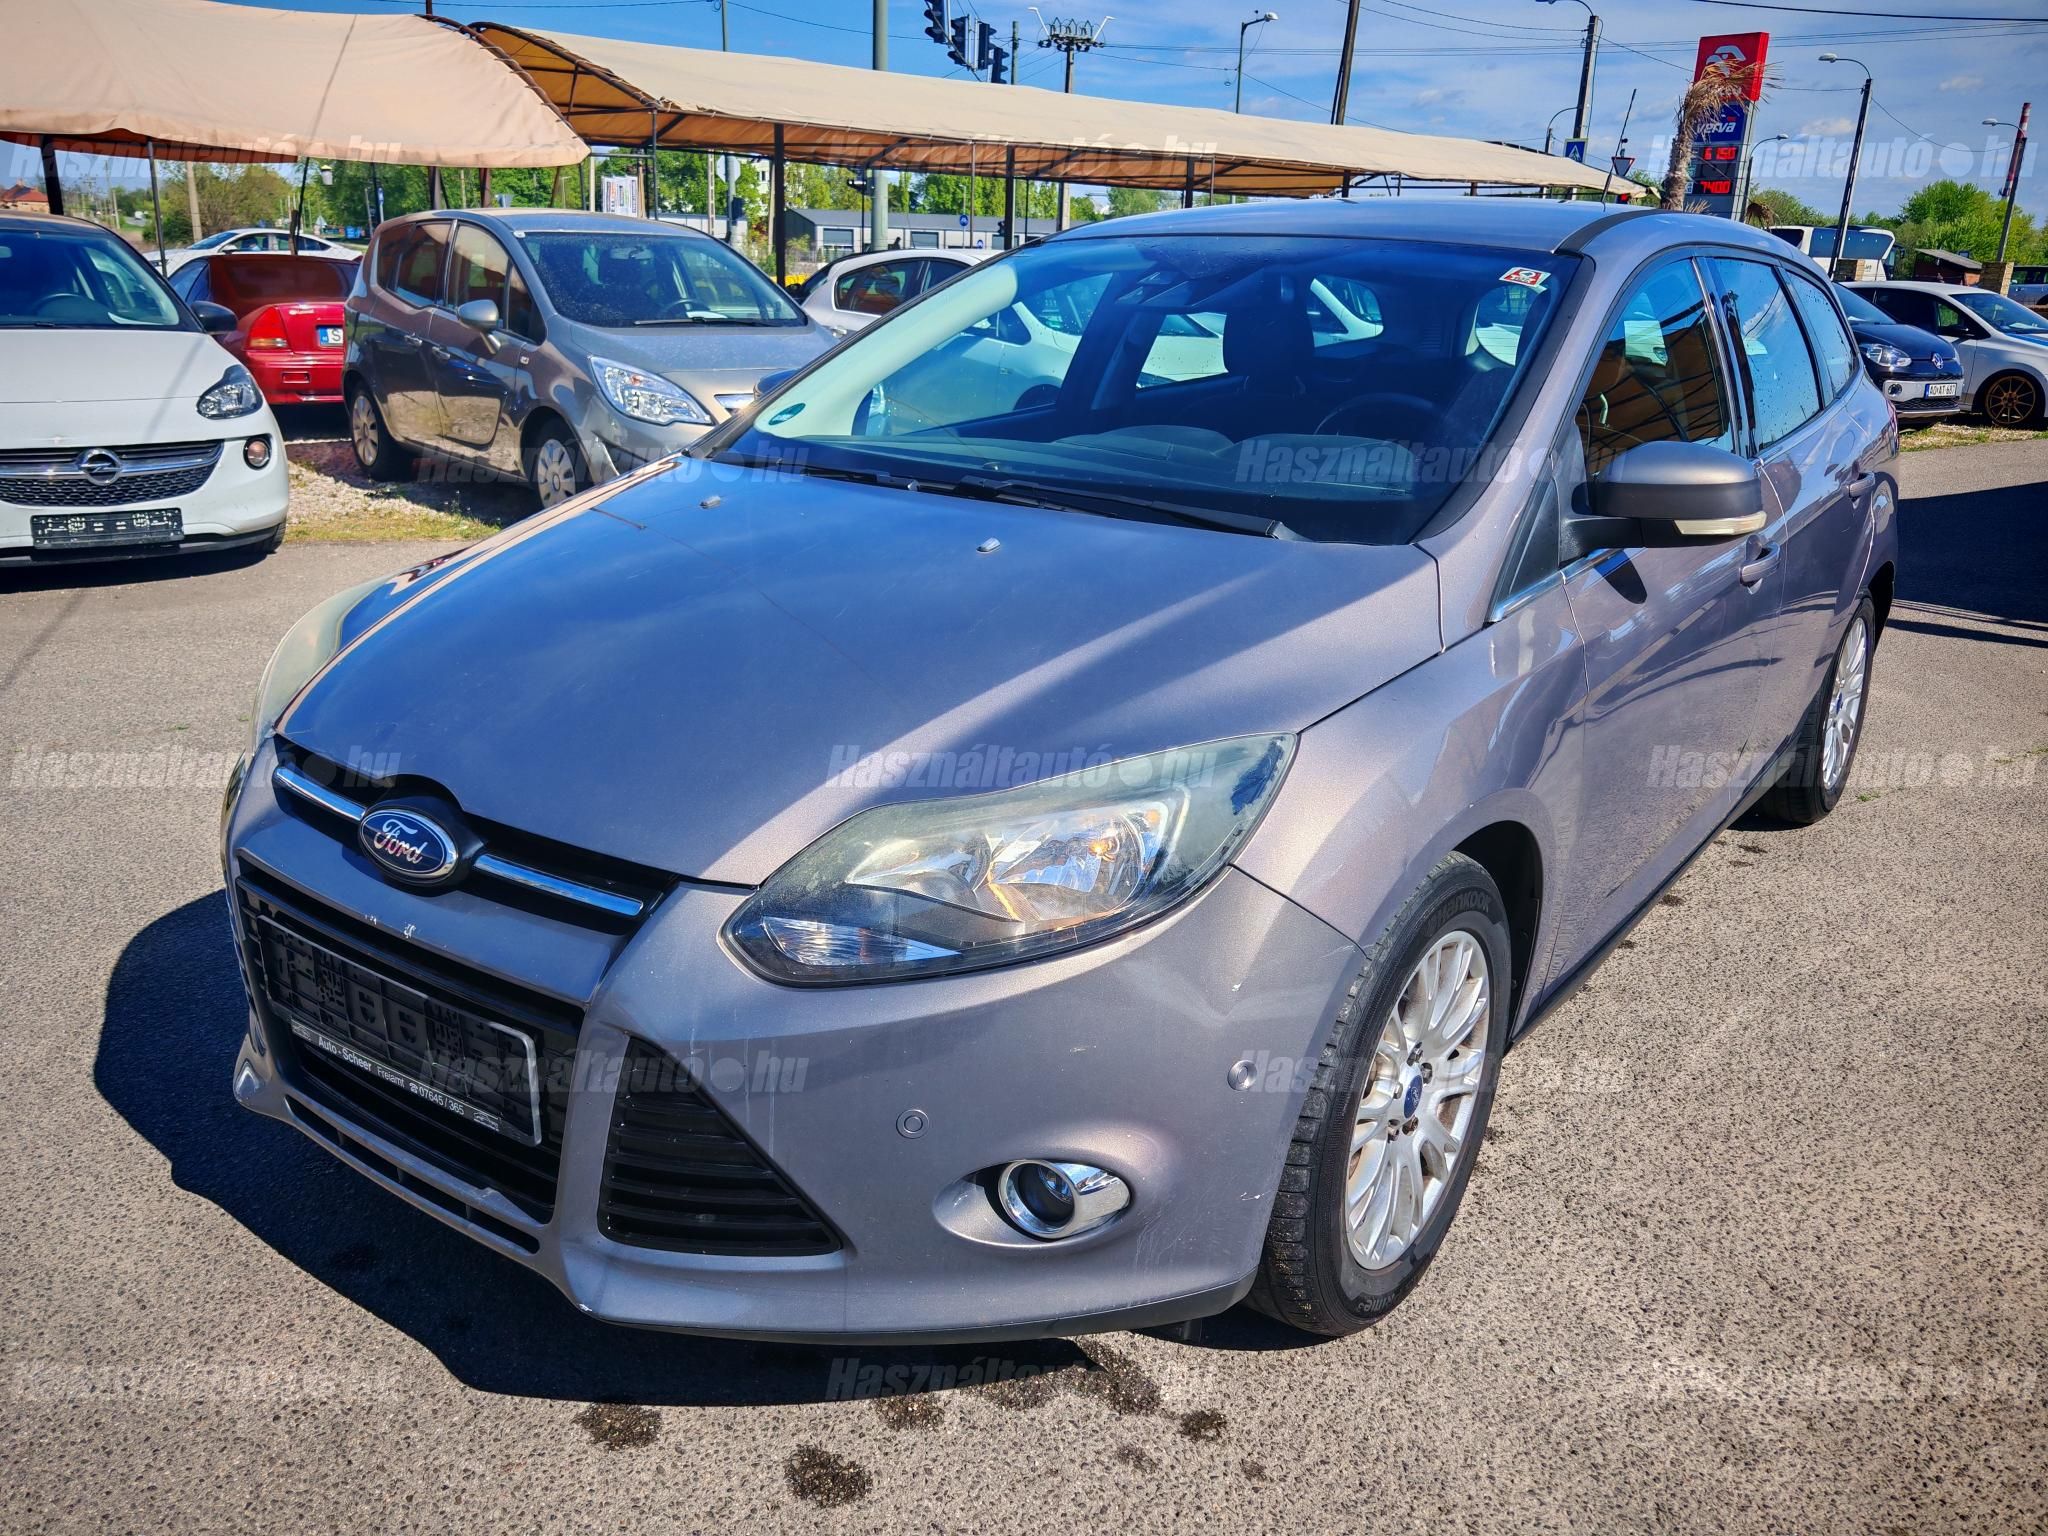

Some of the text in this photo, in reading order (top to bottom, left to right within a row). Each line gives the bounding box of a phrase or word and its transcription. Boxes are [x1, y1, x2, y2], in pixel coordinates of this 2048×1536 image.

[373, 819, 428, 864] Ford
[319, 1036, 337, 1055] Auto
[342, 1047, 372, 1072] Scheer
[377, 1068, 405, 1089] Freiamt
